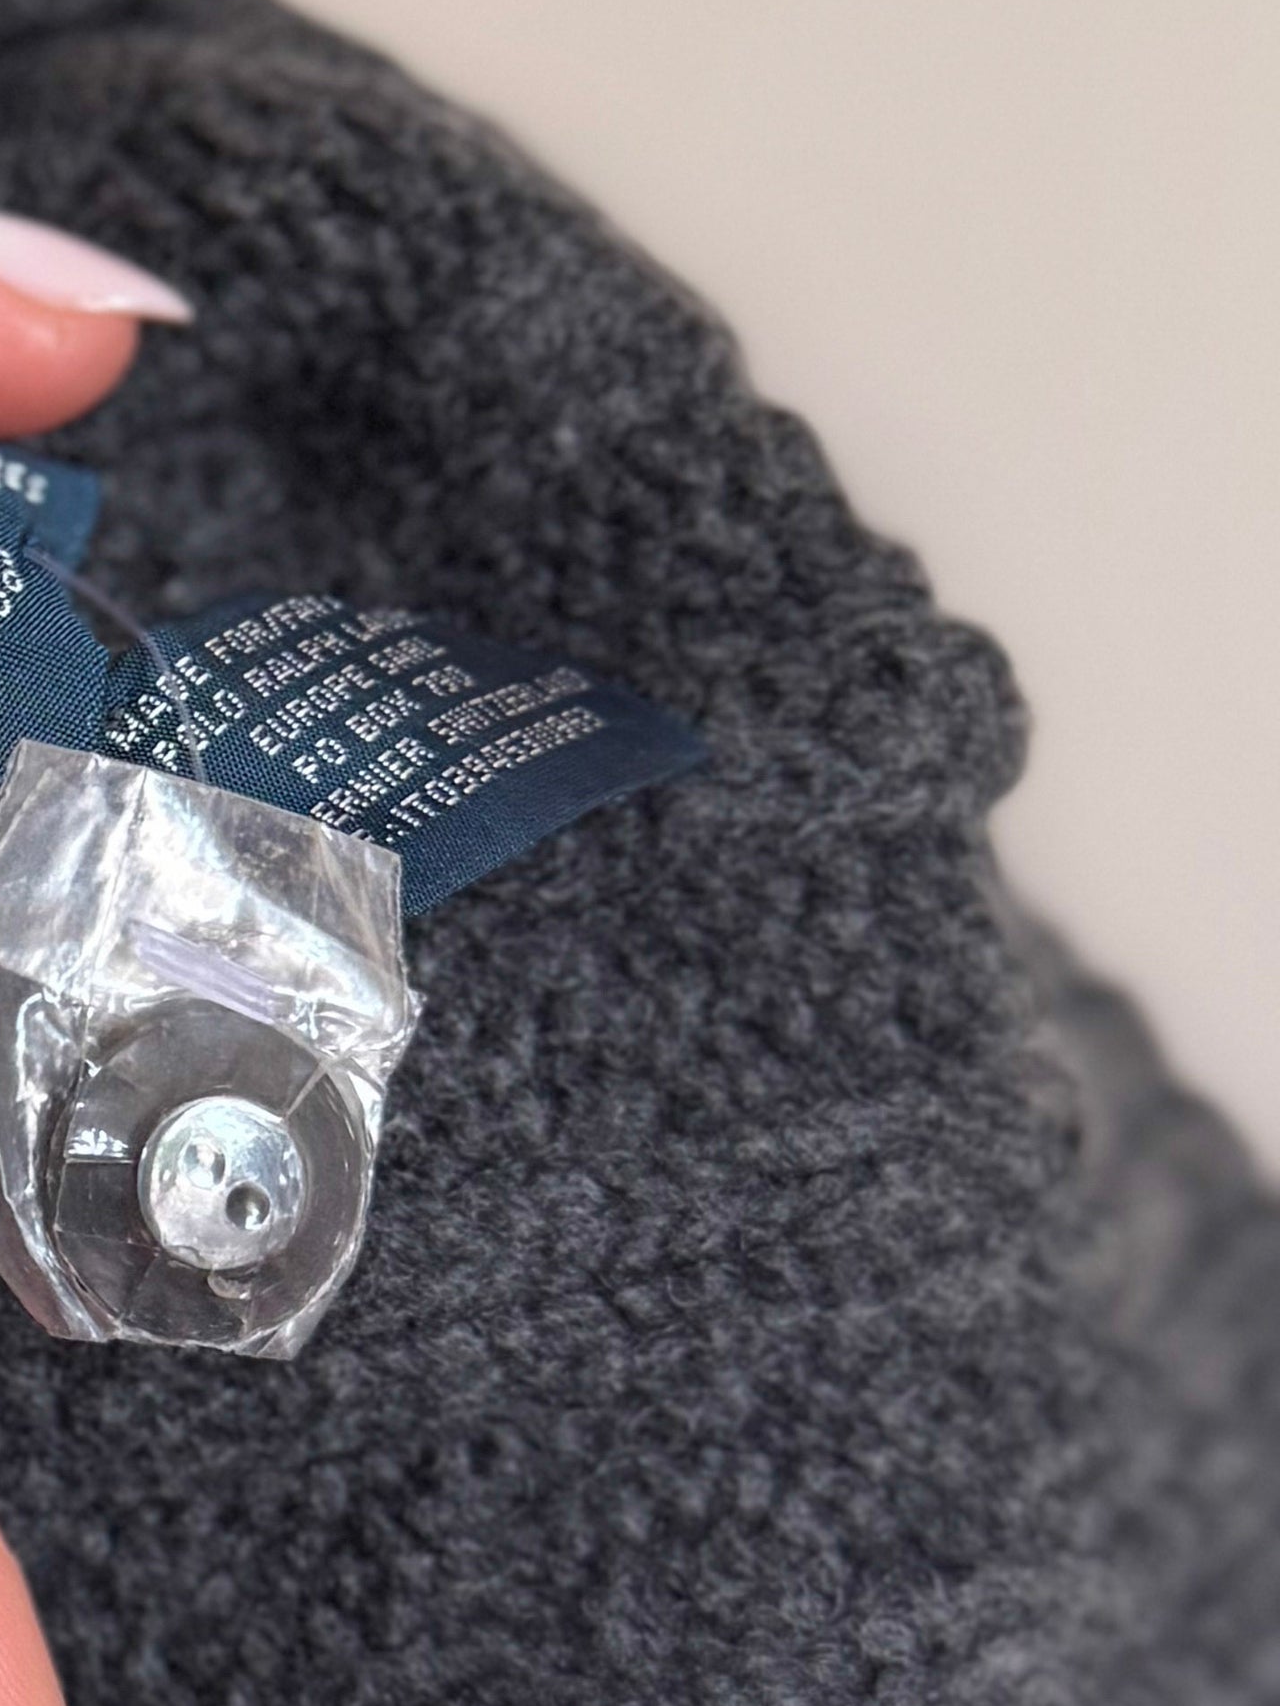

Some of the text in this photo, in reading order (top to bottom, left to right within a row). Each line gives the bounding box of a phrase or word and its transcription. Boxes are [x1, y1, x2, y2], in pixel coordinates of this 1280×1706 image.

[105, 655, 212, 751] MADE
[152, 628, 352, 772] POLO RALPH
[249, 664, 376, 756] EUROPE
[292, 737, 347, 784] PO
[344, 689, 421, 743] BOX
[310, 737, 435, 827] ERNIER
